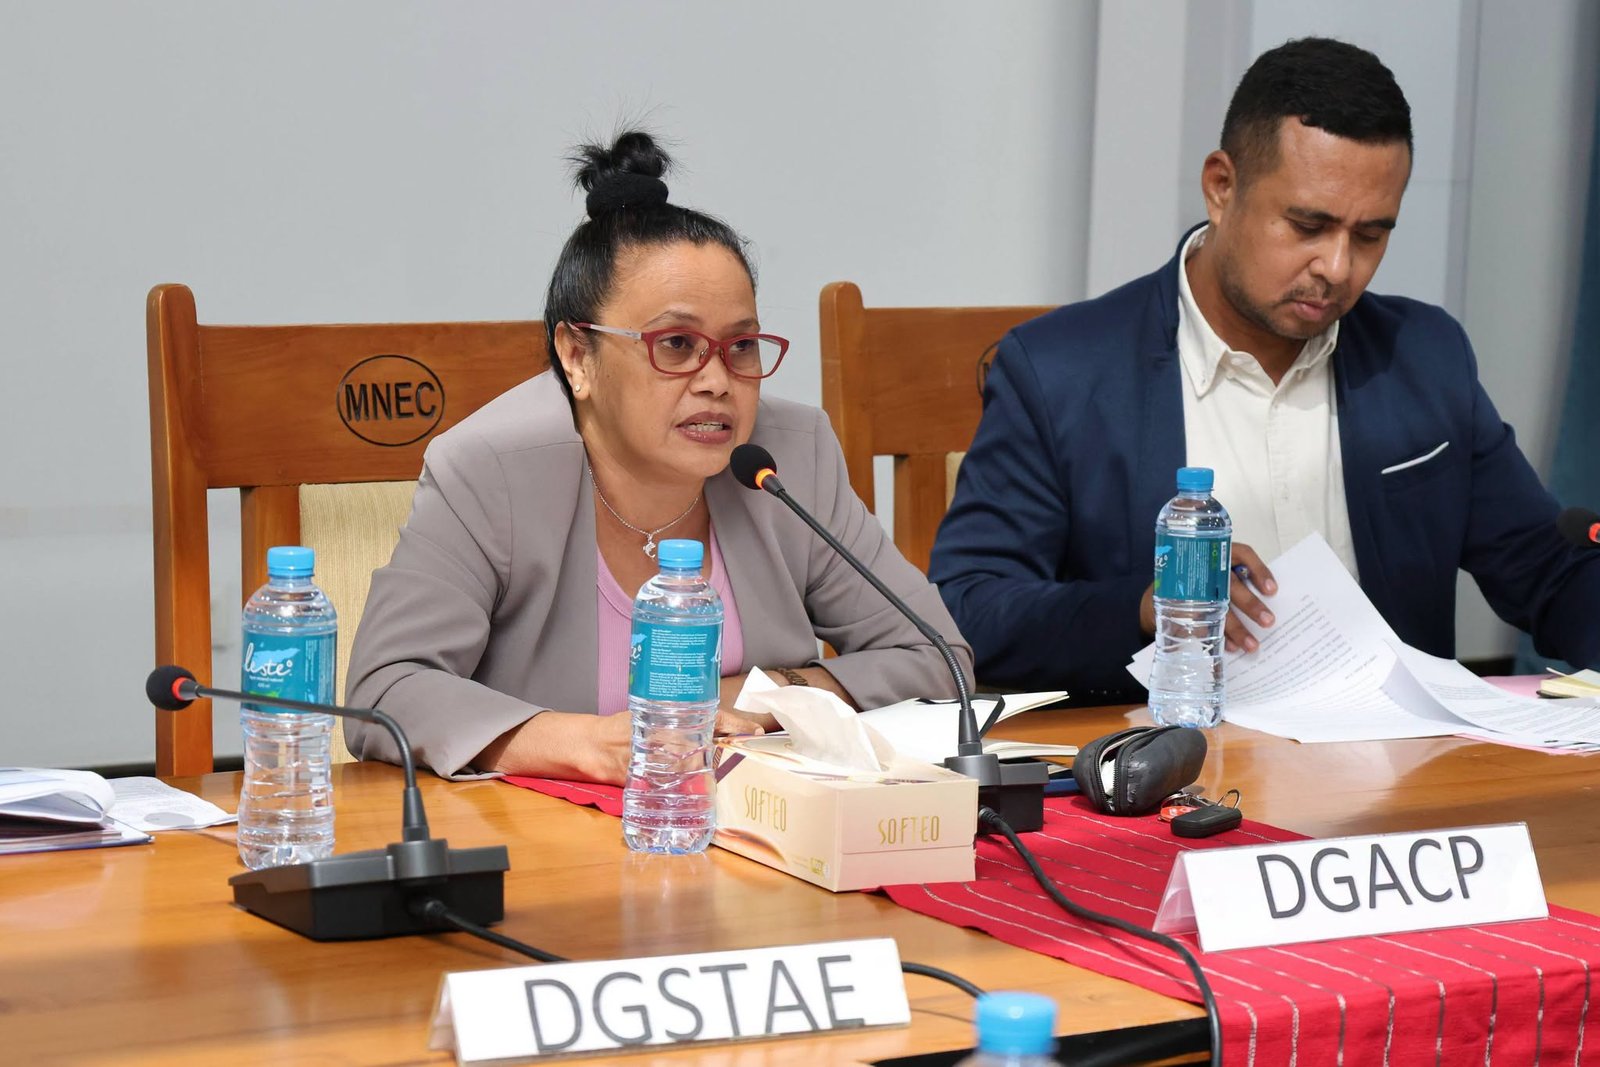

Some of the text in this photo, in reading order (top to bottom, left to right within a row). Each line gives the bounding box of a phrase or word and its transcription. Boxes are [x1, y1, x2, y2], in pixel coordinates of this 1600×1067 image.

[345, 381, 436, 422] MNEC
[744, 784, 787, 832] SOFTEO
[878, 815, 940, 845] SOFTEO
[1256, 835, 1484, 919] DGACP
[524, 955, 865, 1054] DGSTAE
